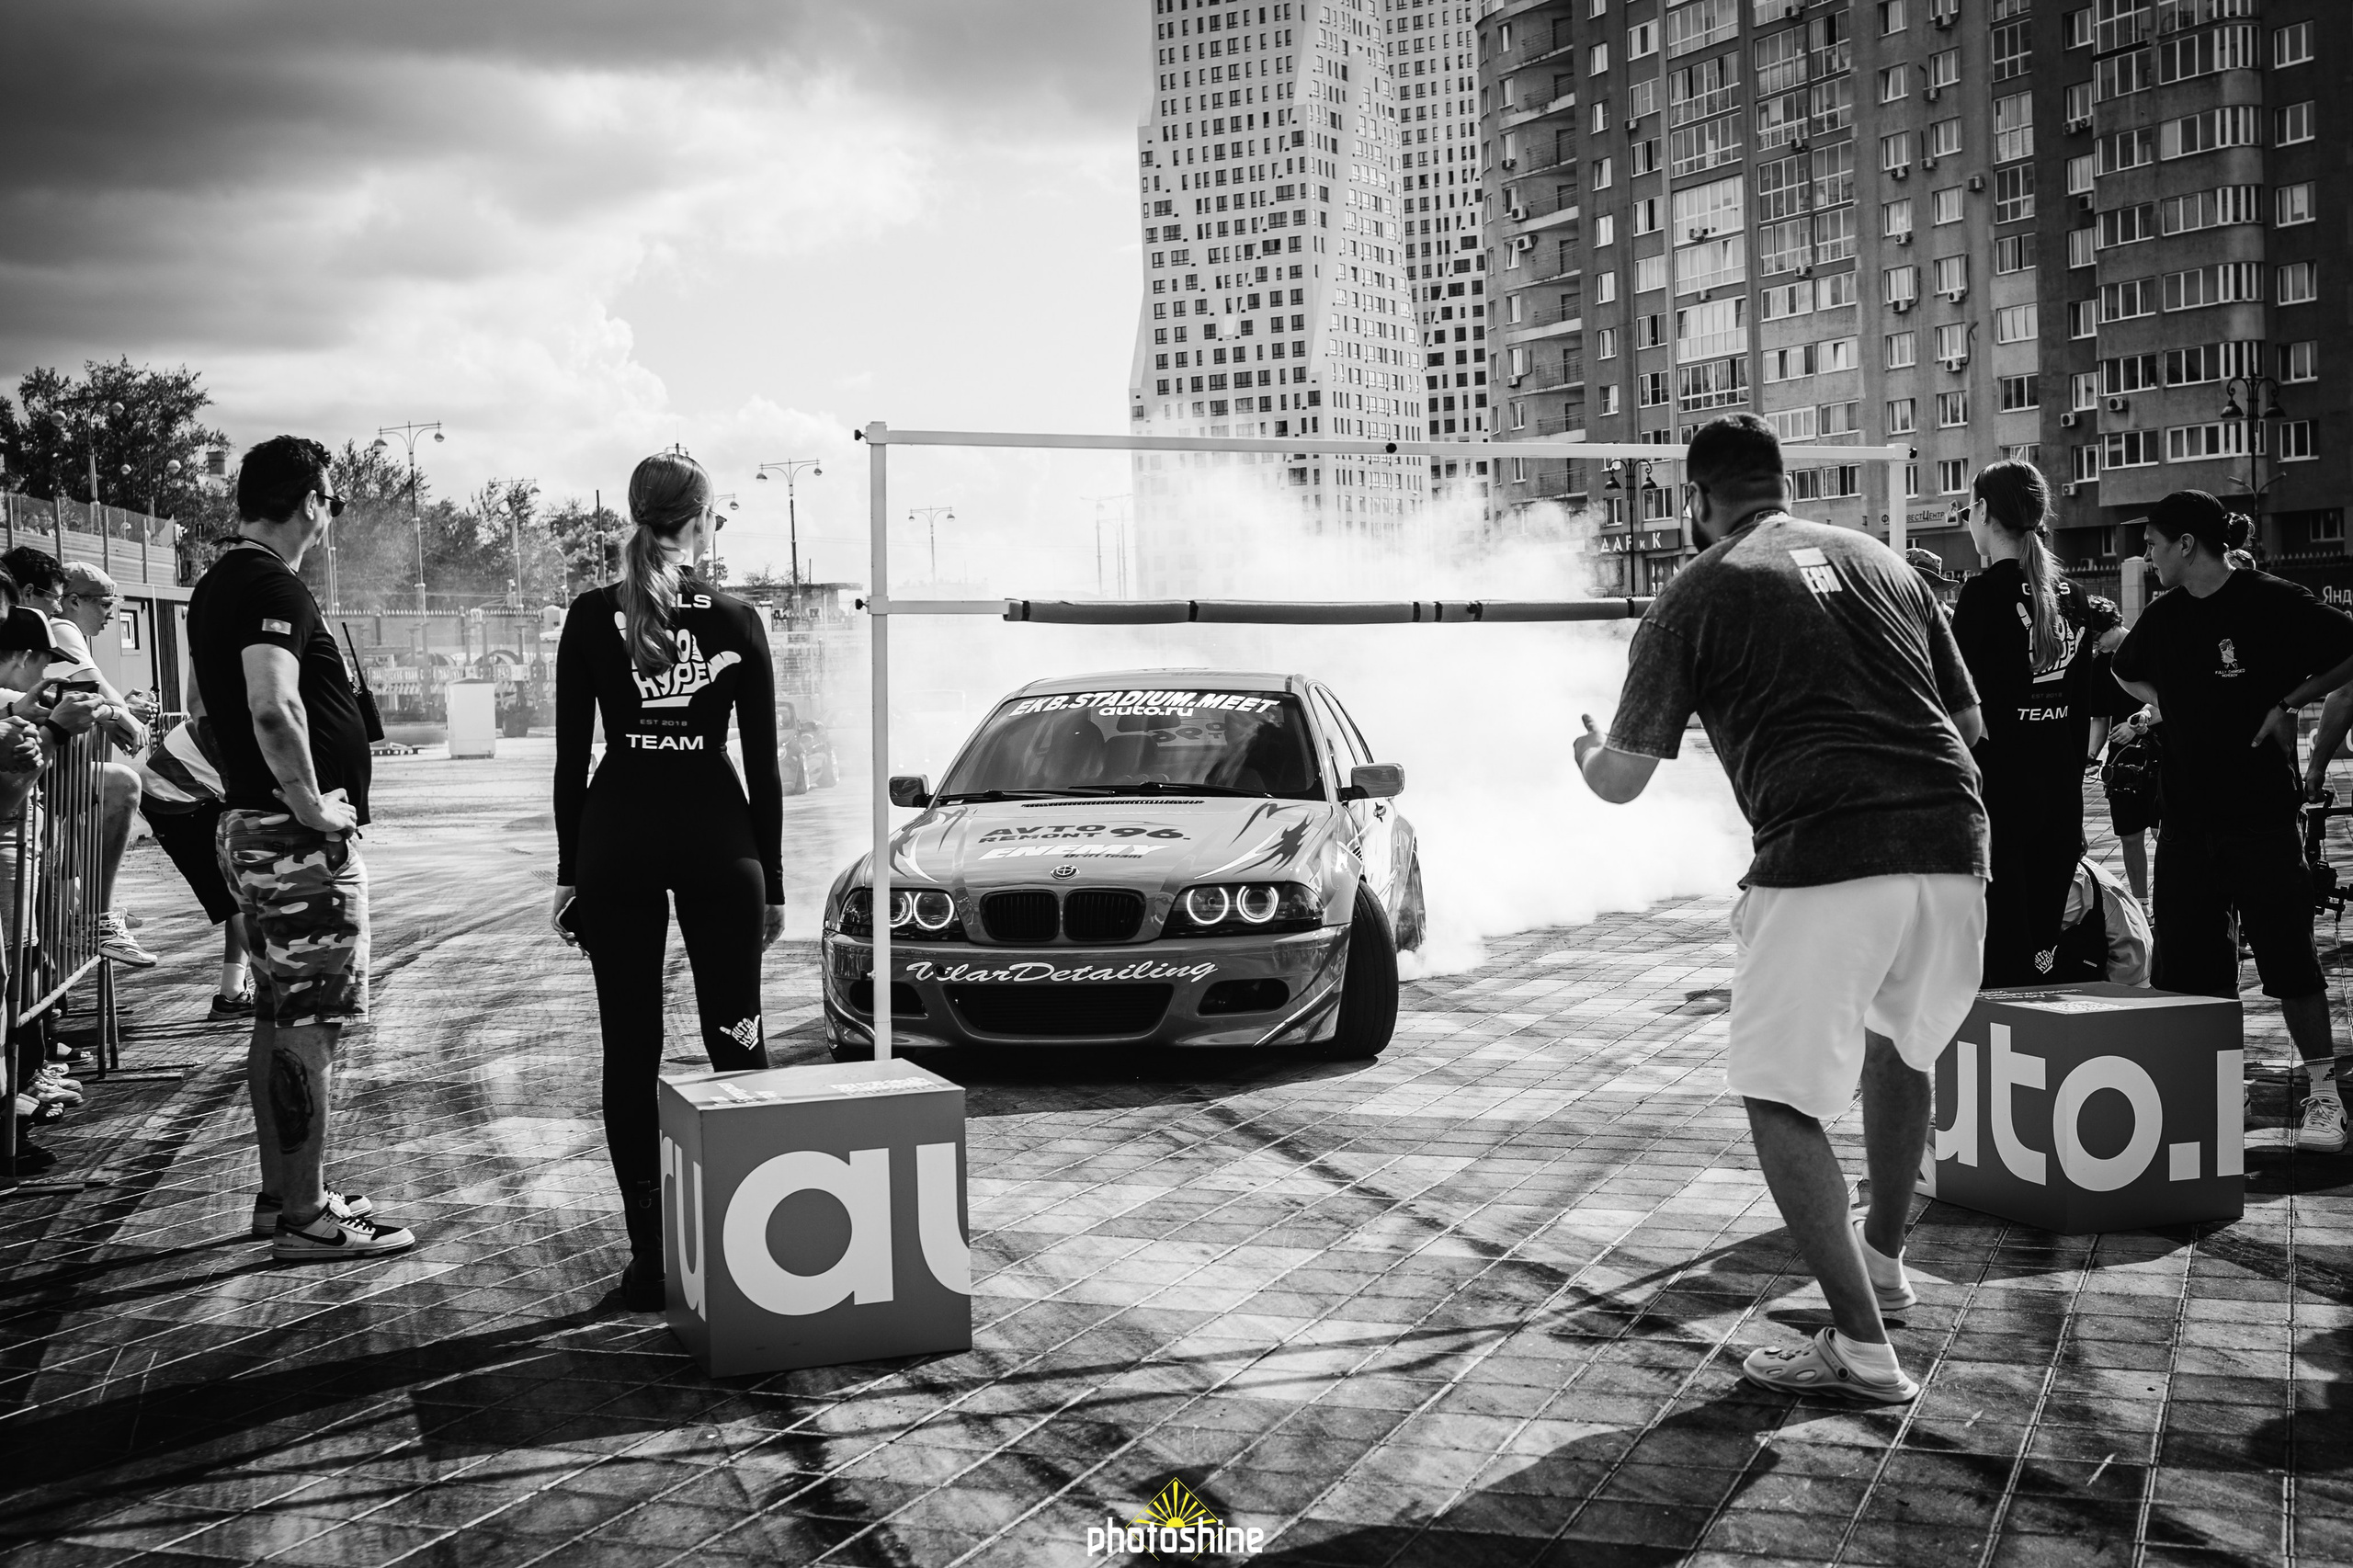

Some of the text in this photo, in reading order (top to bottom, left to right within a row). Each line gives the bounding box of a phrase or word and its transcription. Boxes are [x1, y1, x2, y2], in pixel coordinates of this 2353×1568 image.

[2323, 585, 2353, 606] Янд
[1098, 706, 1194, 717] auto.ru
[2018, 706, 2068, 721] TEAM
[626, 734, 704, 750] TEAM
[978, 832, 1102, 843] REMONT
[983, 825, 1107, 837] AVTO
[978, 844, 1170, 860] ENEMY
